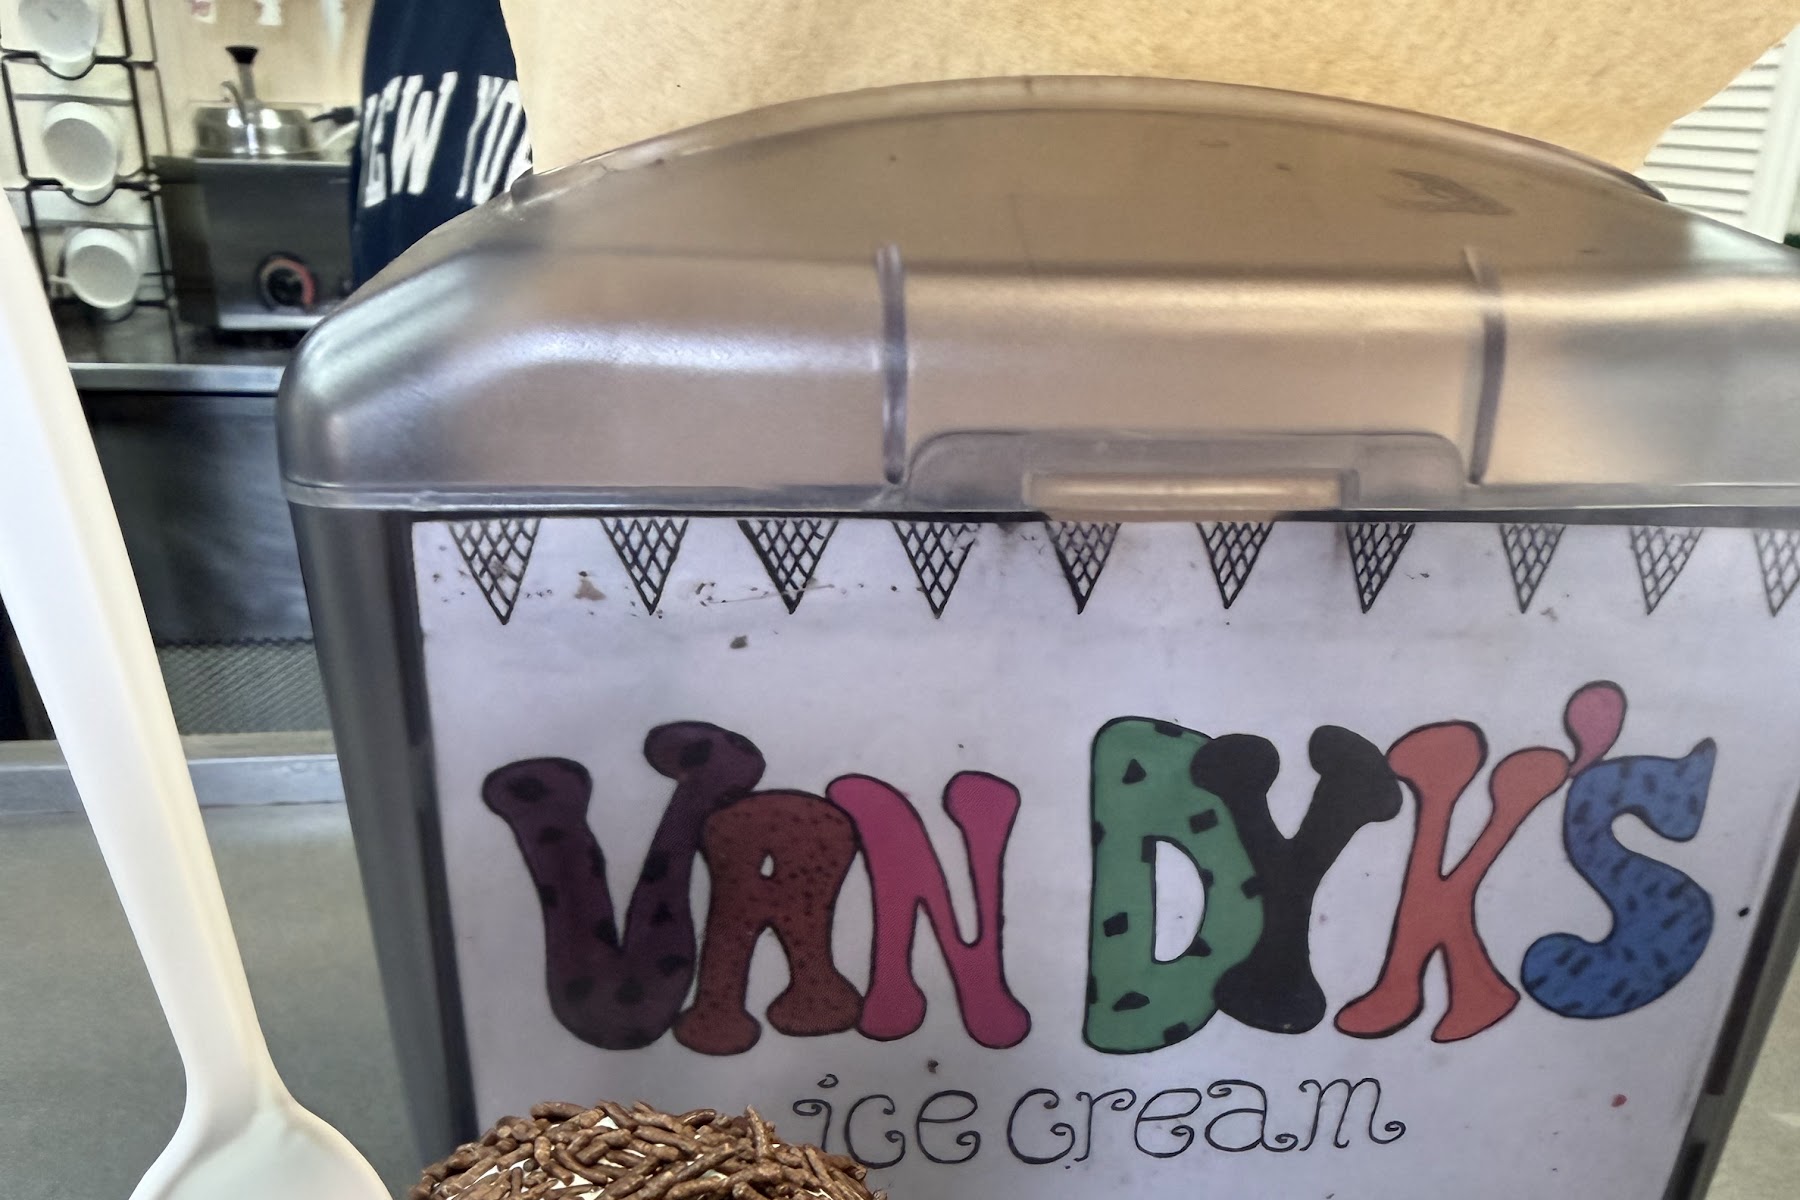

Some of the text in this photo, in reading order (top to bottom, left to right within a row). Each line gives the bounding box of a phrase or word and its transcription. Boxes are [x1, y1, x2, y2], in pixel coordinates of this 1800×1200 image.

[482, 680, 1717, 1056] VAN DYK'S
[793, 1073, 1406, 1169] ice cream
